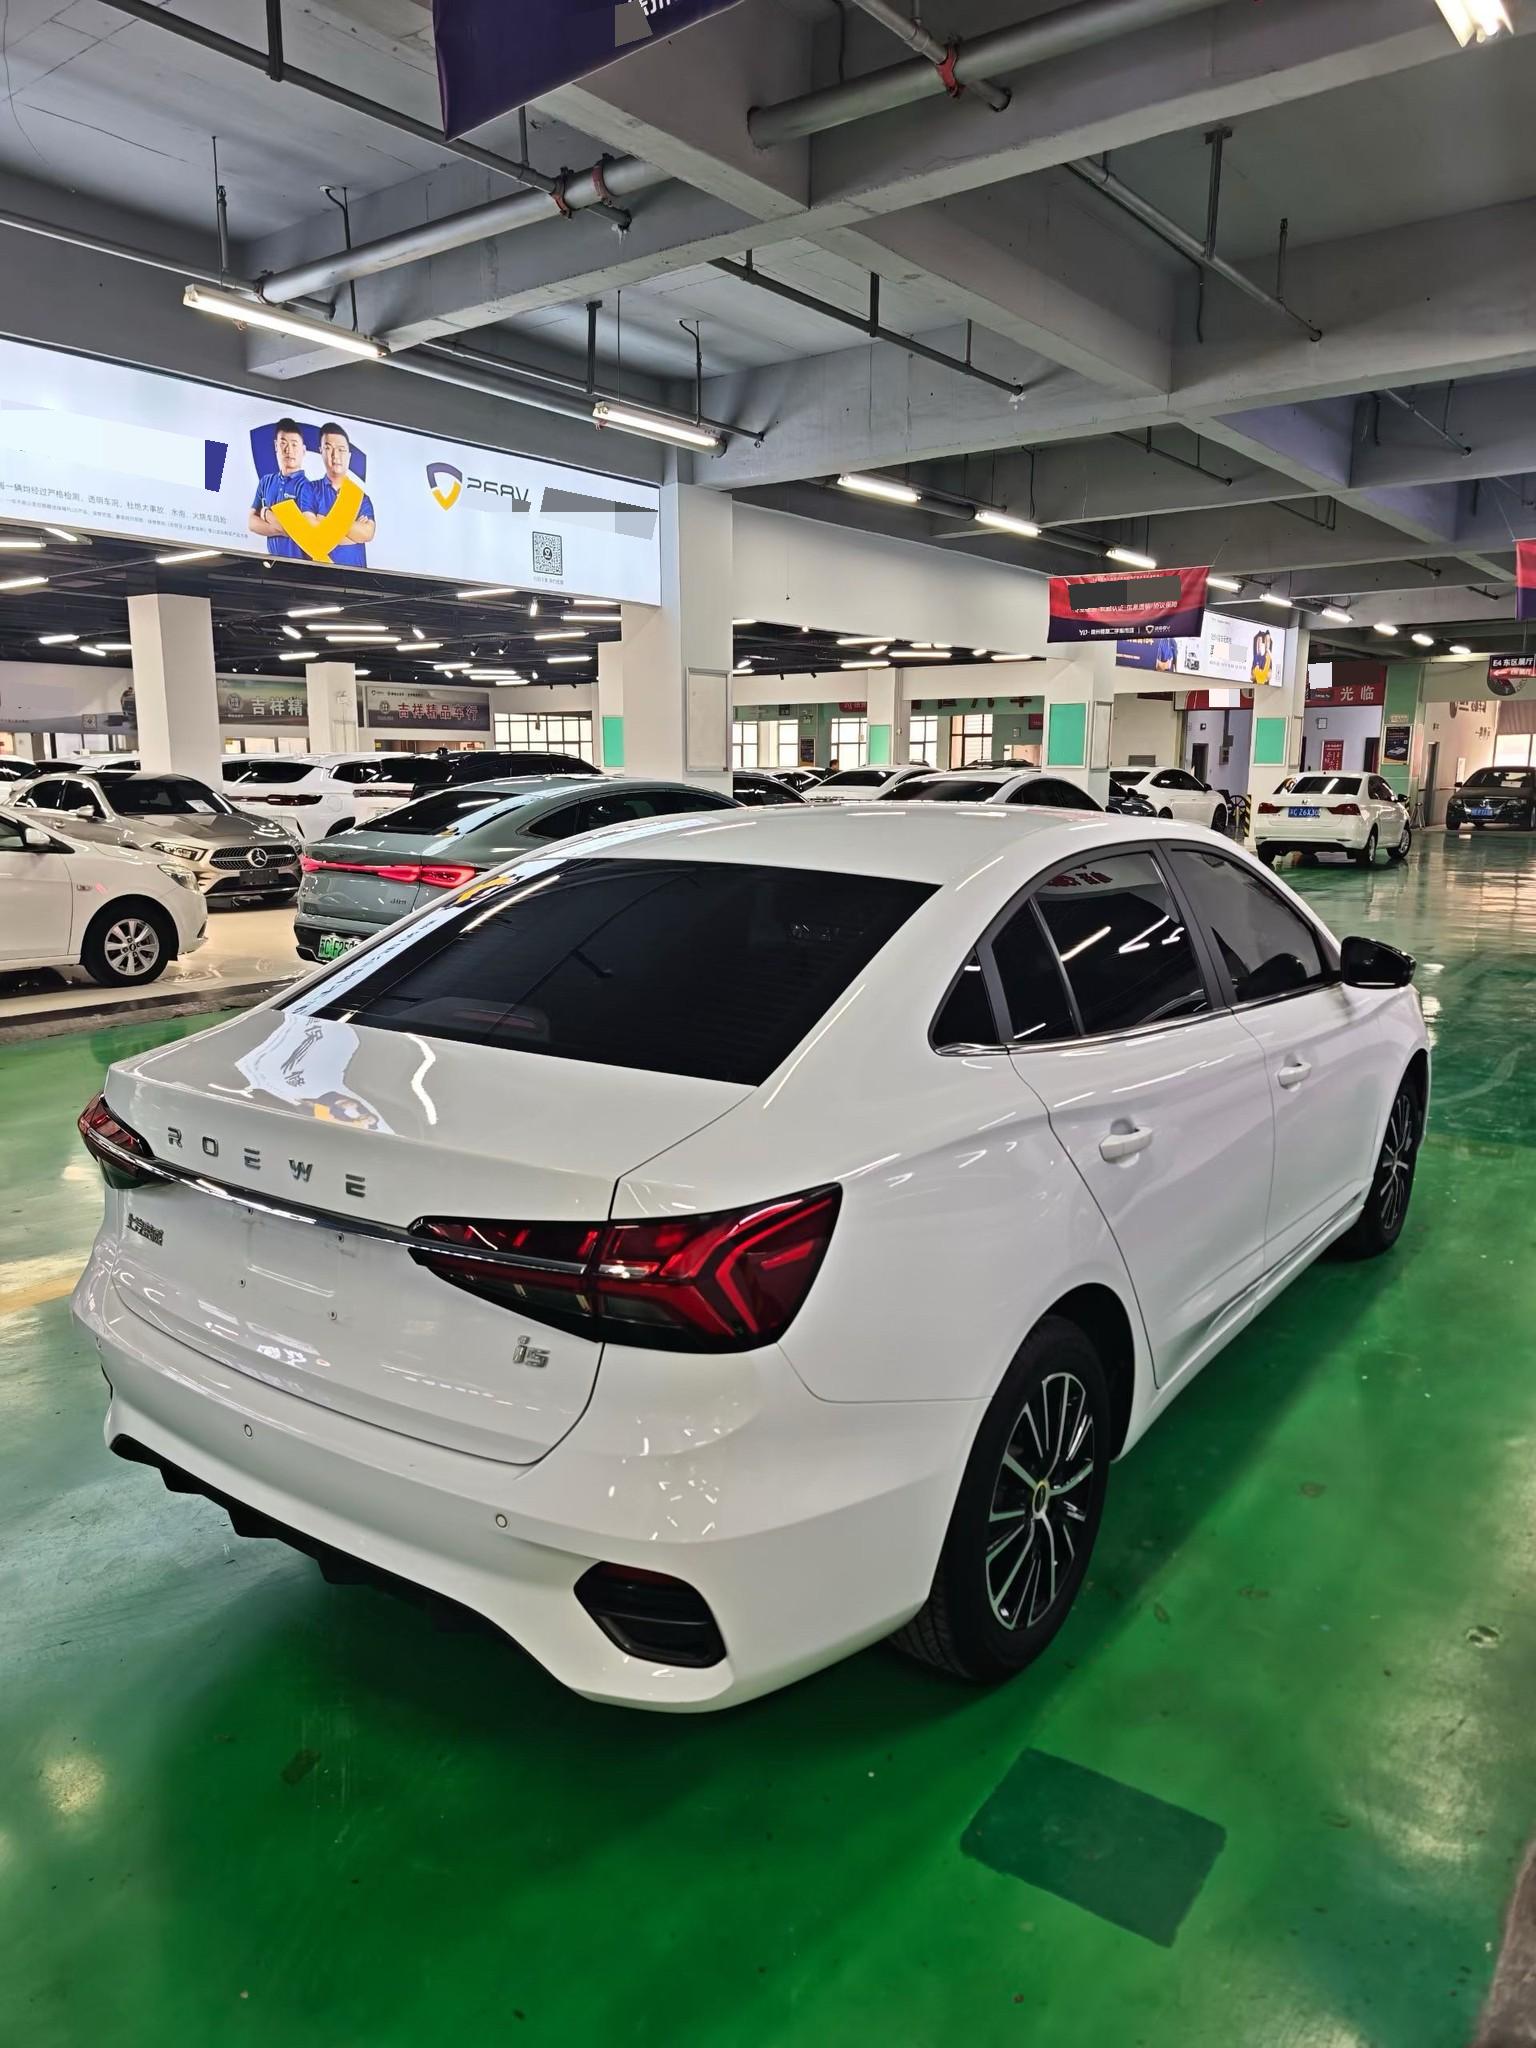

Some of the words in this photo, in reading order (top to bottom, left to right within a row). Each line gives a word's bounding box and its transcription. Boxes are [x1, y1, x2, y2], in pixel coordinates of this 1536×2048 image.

[398, 702, 478, 721] 吉祥精品车行
[168, 1126, 366, 1198] ROEWE
[512, 1335, 551, 1368] i5
